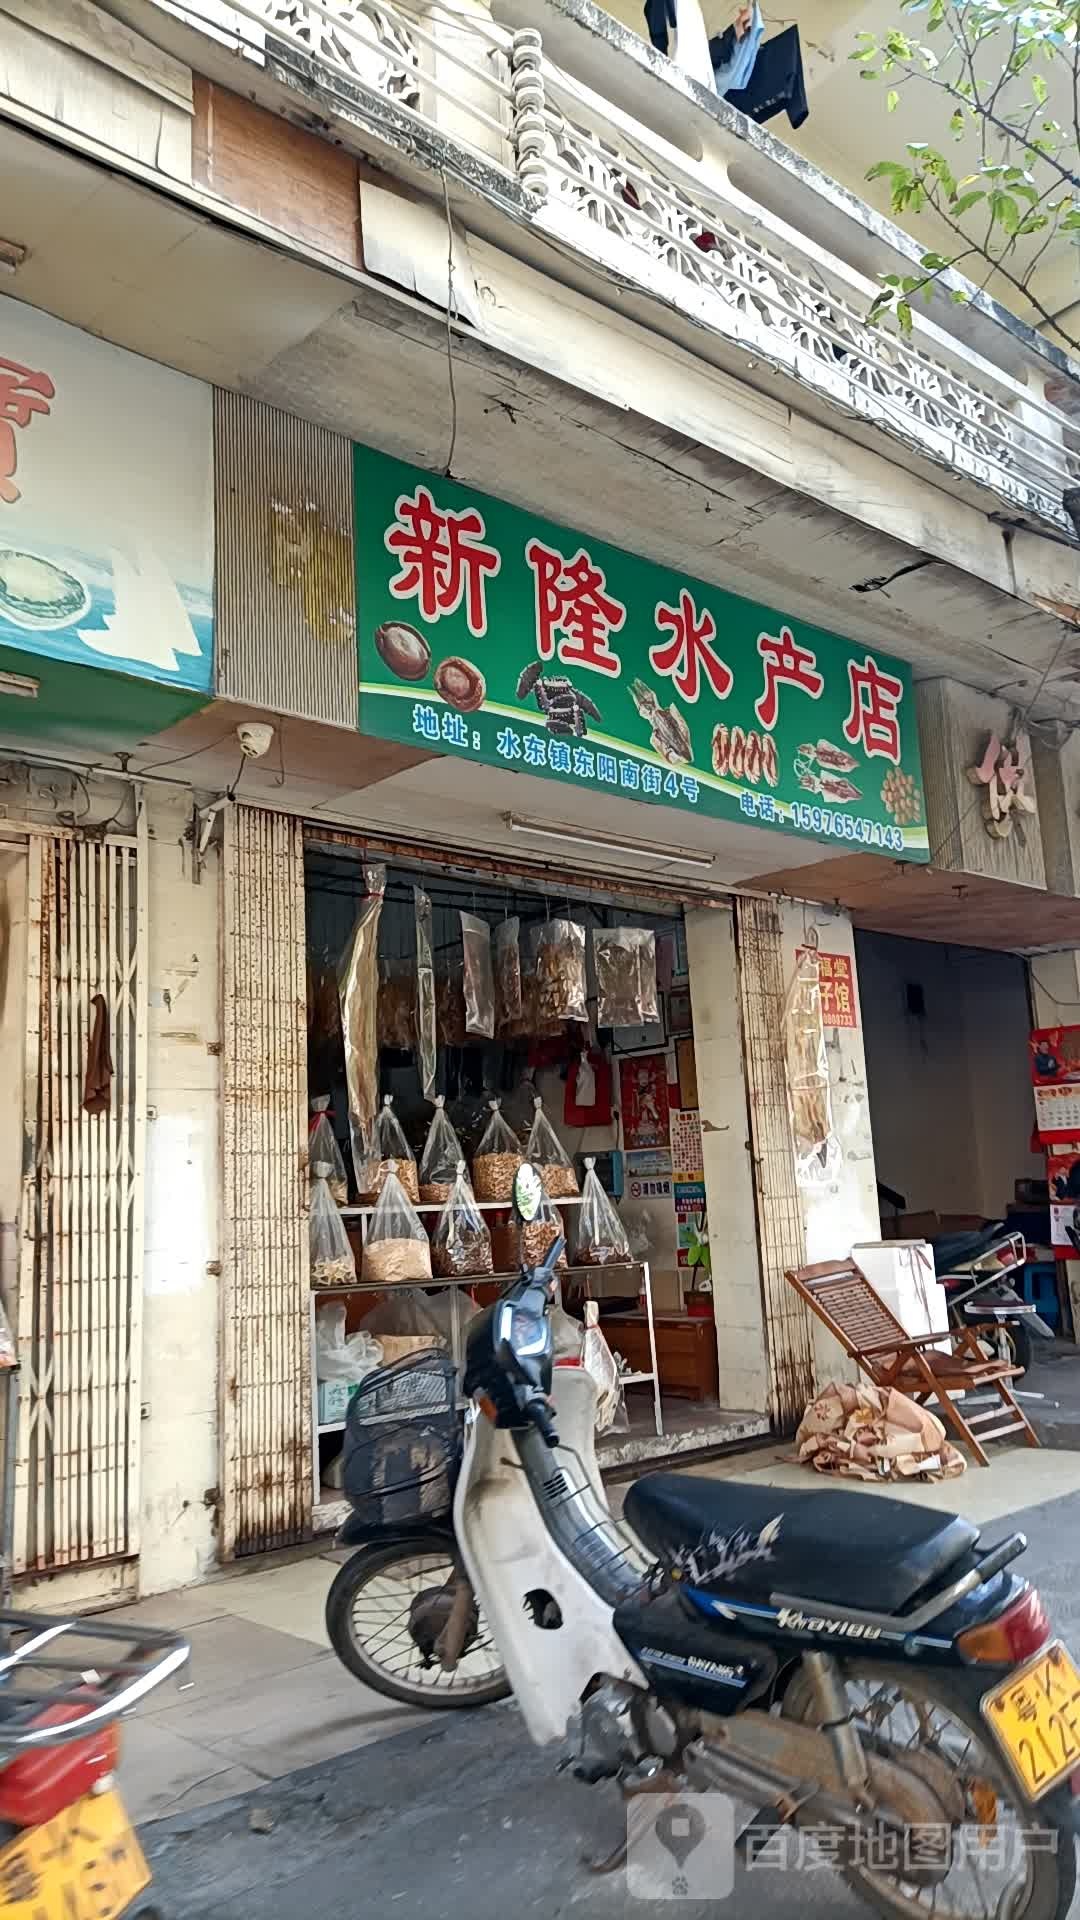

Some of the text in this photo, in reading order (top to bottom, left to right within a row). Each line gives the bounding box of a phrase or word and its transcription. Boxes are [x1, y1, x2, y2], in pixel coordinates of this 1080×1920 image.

[385, 485, 903, 764] 新隆水产店
